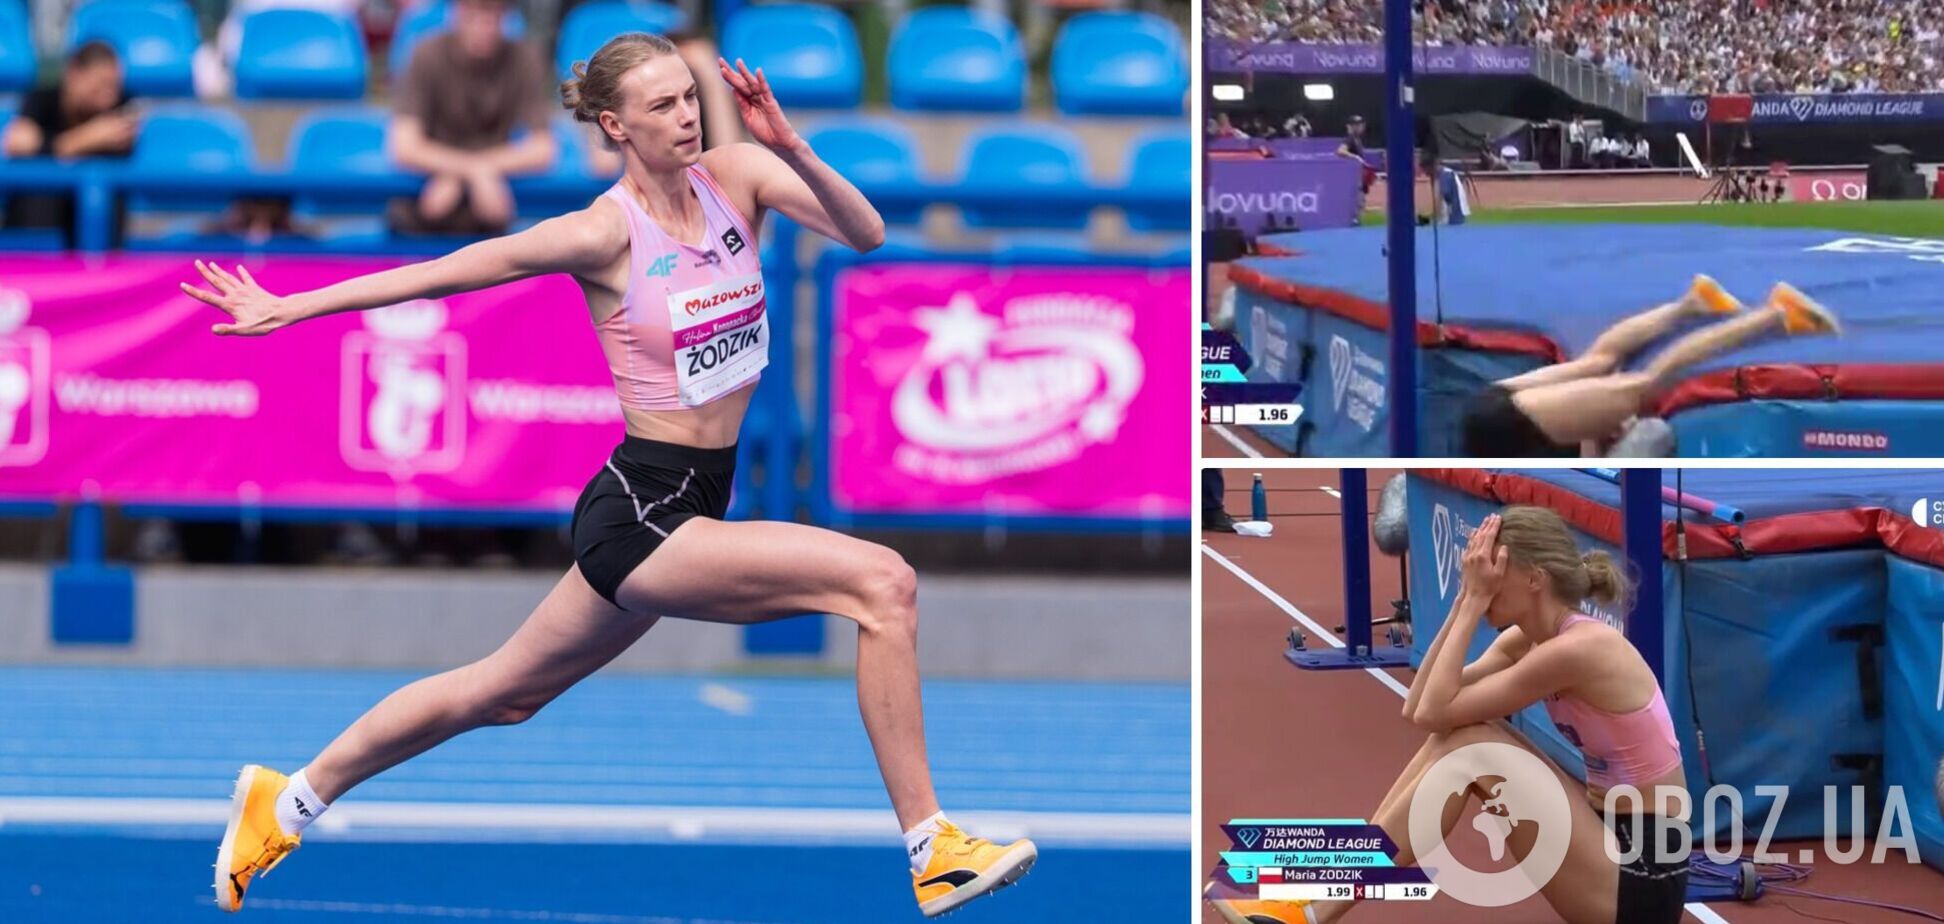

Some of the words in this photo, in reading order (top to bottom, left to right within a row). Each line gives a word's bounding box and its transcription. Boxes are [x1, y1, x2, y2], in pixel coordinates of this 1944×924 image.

[1312, 51, 1377, 67] Novuna
[1471, 52, 1530, 68] Novuna
[1814, 101, 1873, 116] DIAMOND
[1875, 101, 1924, 115] LEAGUE
[687, 324, 762, 377] ŻODZIK
[1817, 432, 1888, 448] MONDO
